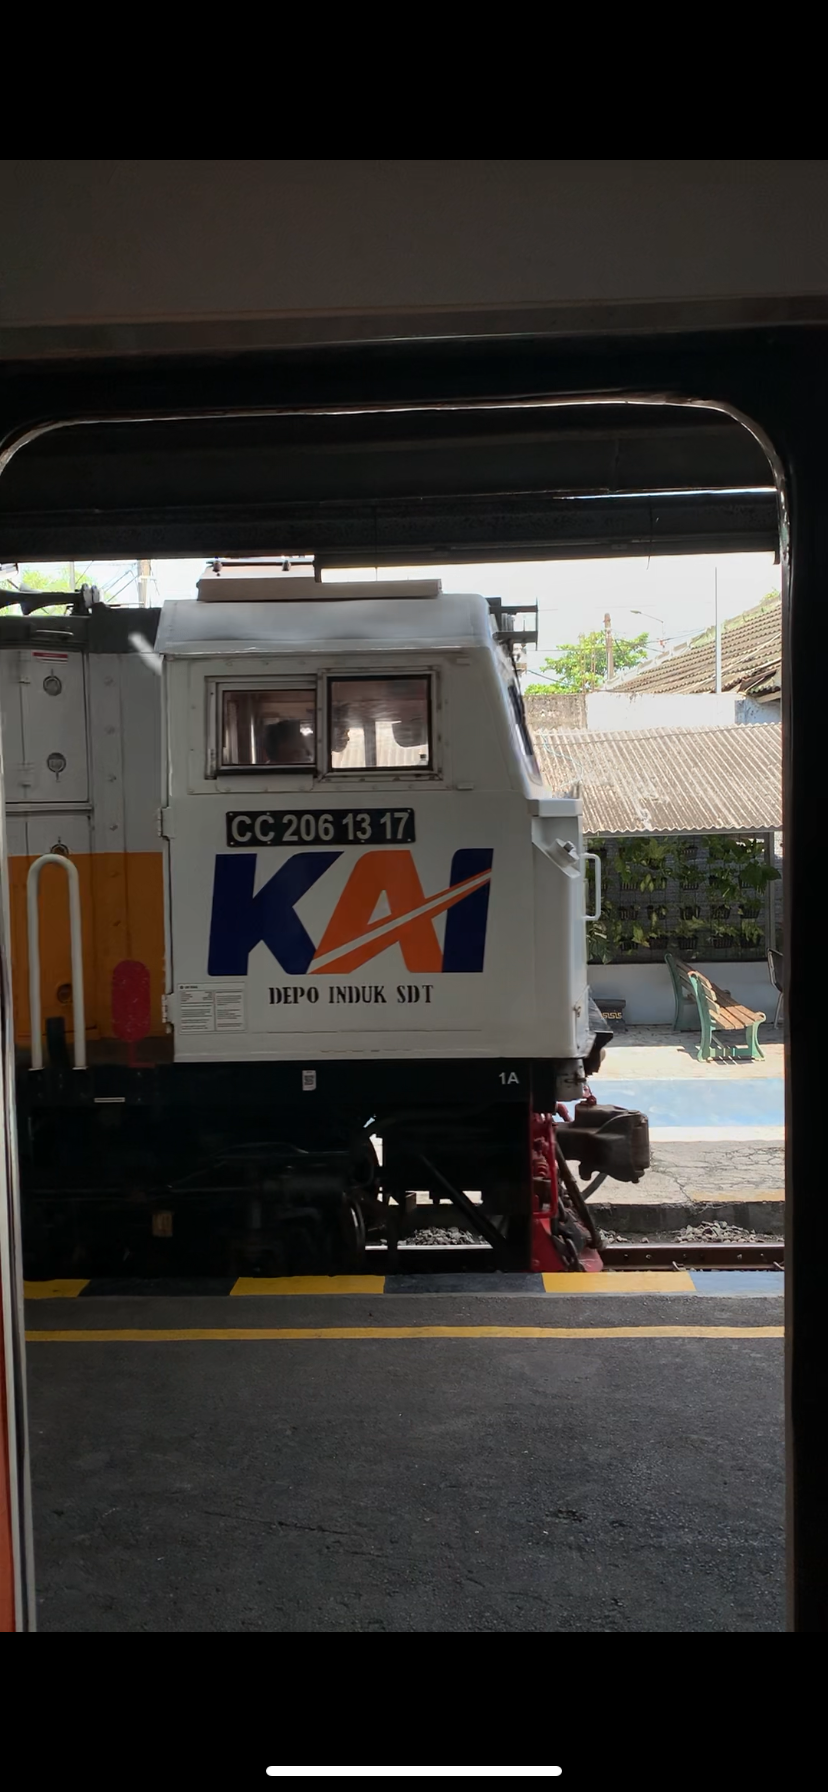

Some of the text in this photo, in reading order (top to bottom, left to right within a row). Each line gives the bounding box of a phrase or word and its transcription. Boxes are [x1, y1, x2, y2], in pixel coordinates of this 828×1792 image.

[231, 812, 410, 842] CC 206 13 17
[207, 848, 494, 976] KAI
[268, 984, 433, 1005] DEPO INDUK SDT
[498, 1071, 520, 1085] 1A
